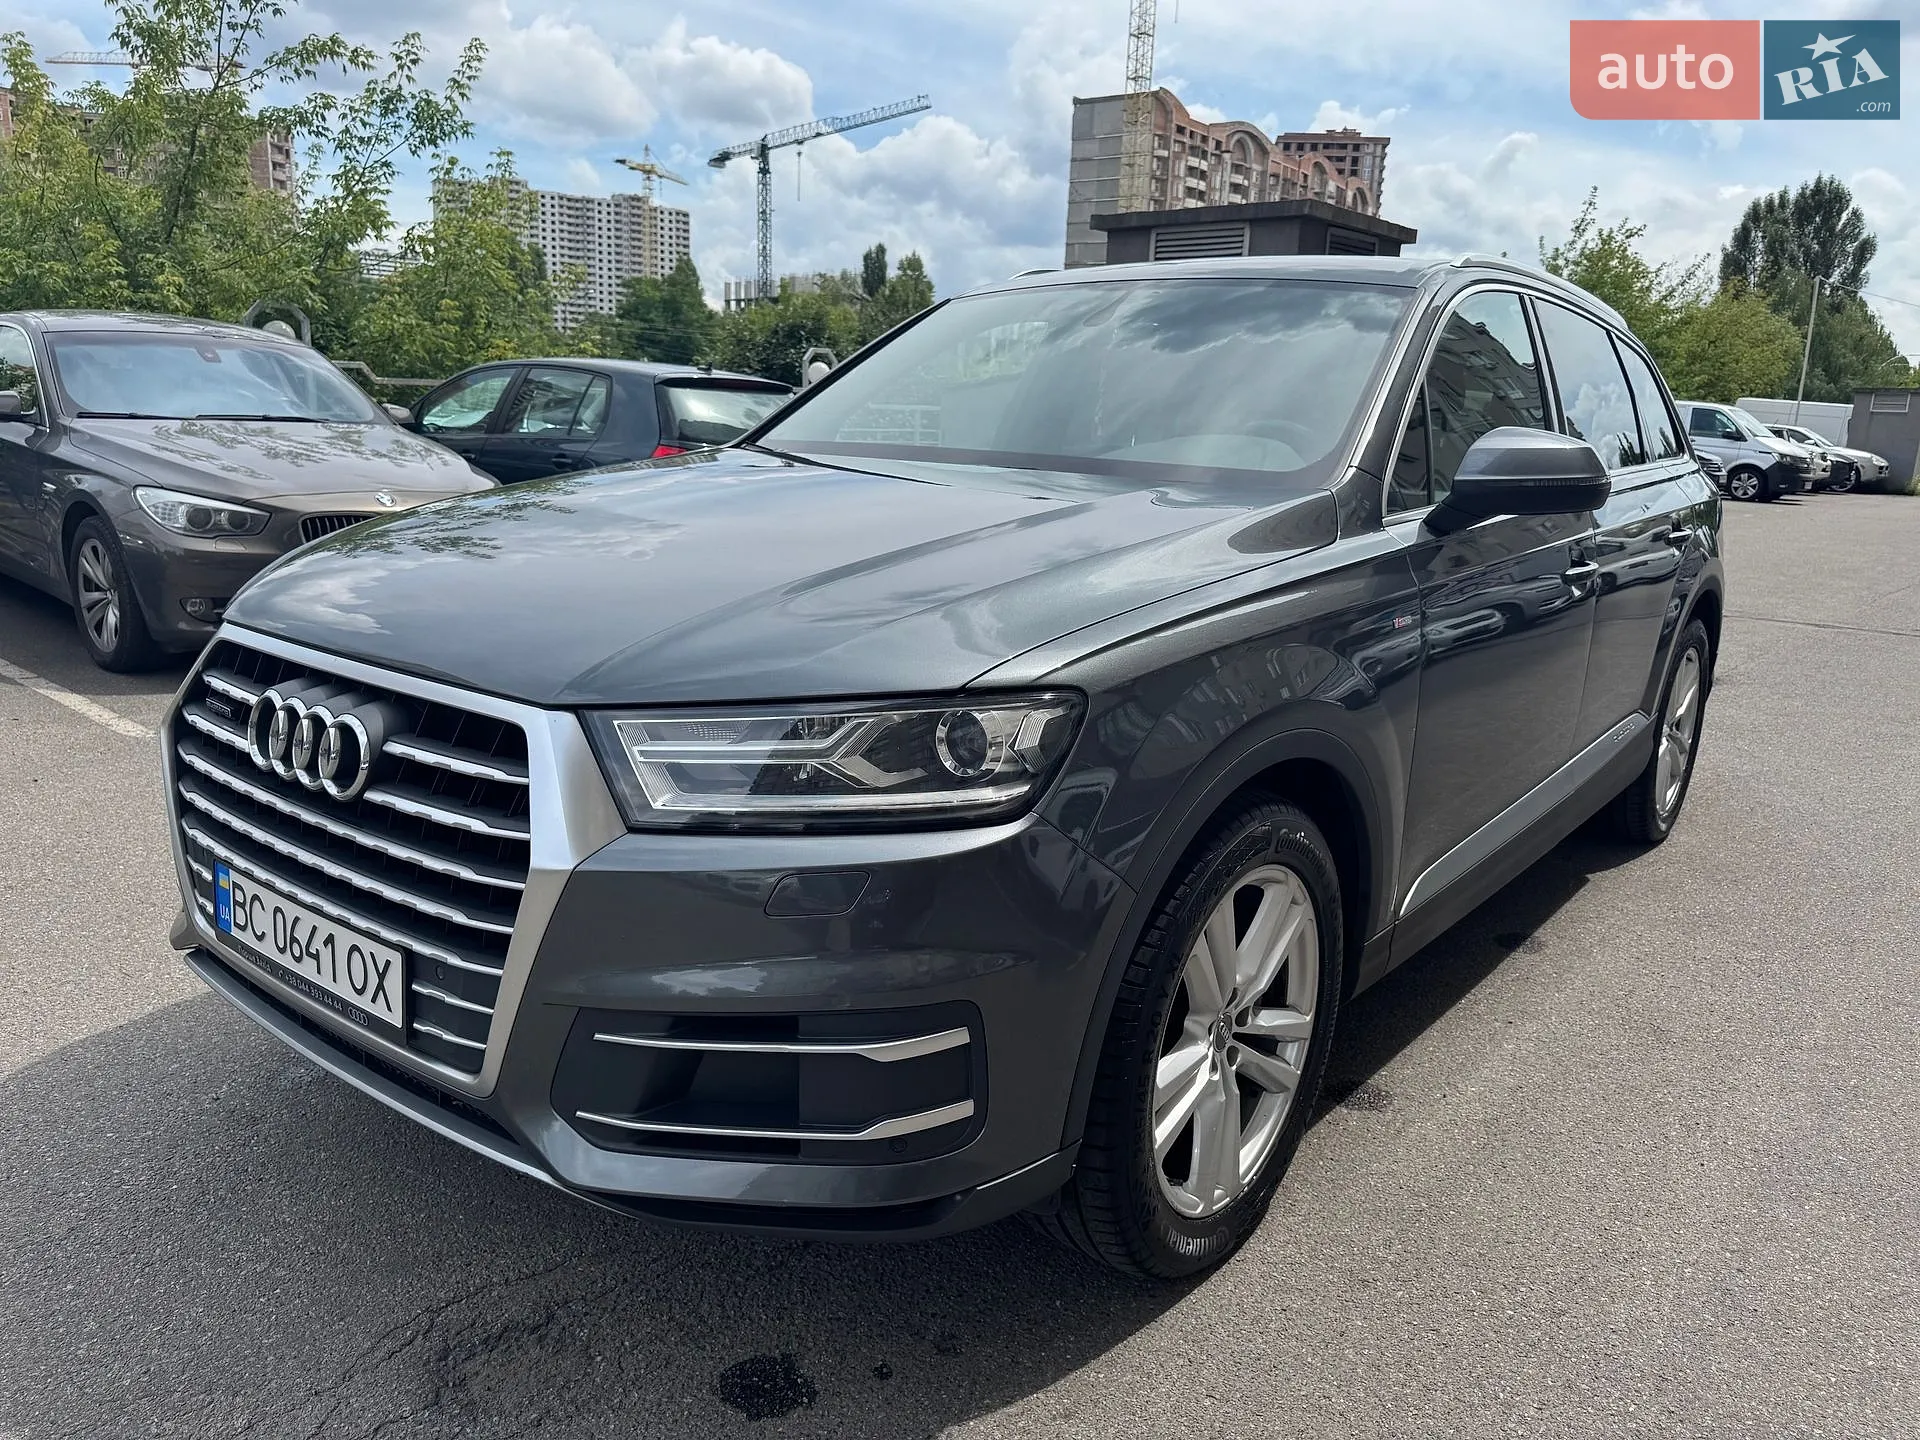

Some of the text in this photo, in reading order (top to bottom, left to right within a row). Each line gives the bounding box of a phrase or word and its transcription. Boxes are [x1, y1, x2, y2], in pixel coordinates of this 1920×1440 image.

[220, 904, 230, 922] UA
[232, 880, 266, 942] BC
[273, 905, 338, 984] 0641
[347, 944, 393, 1013] OX
